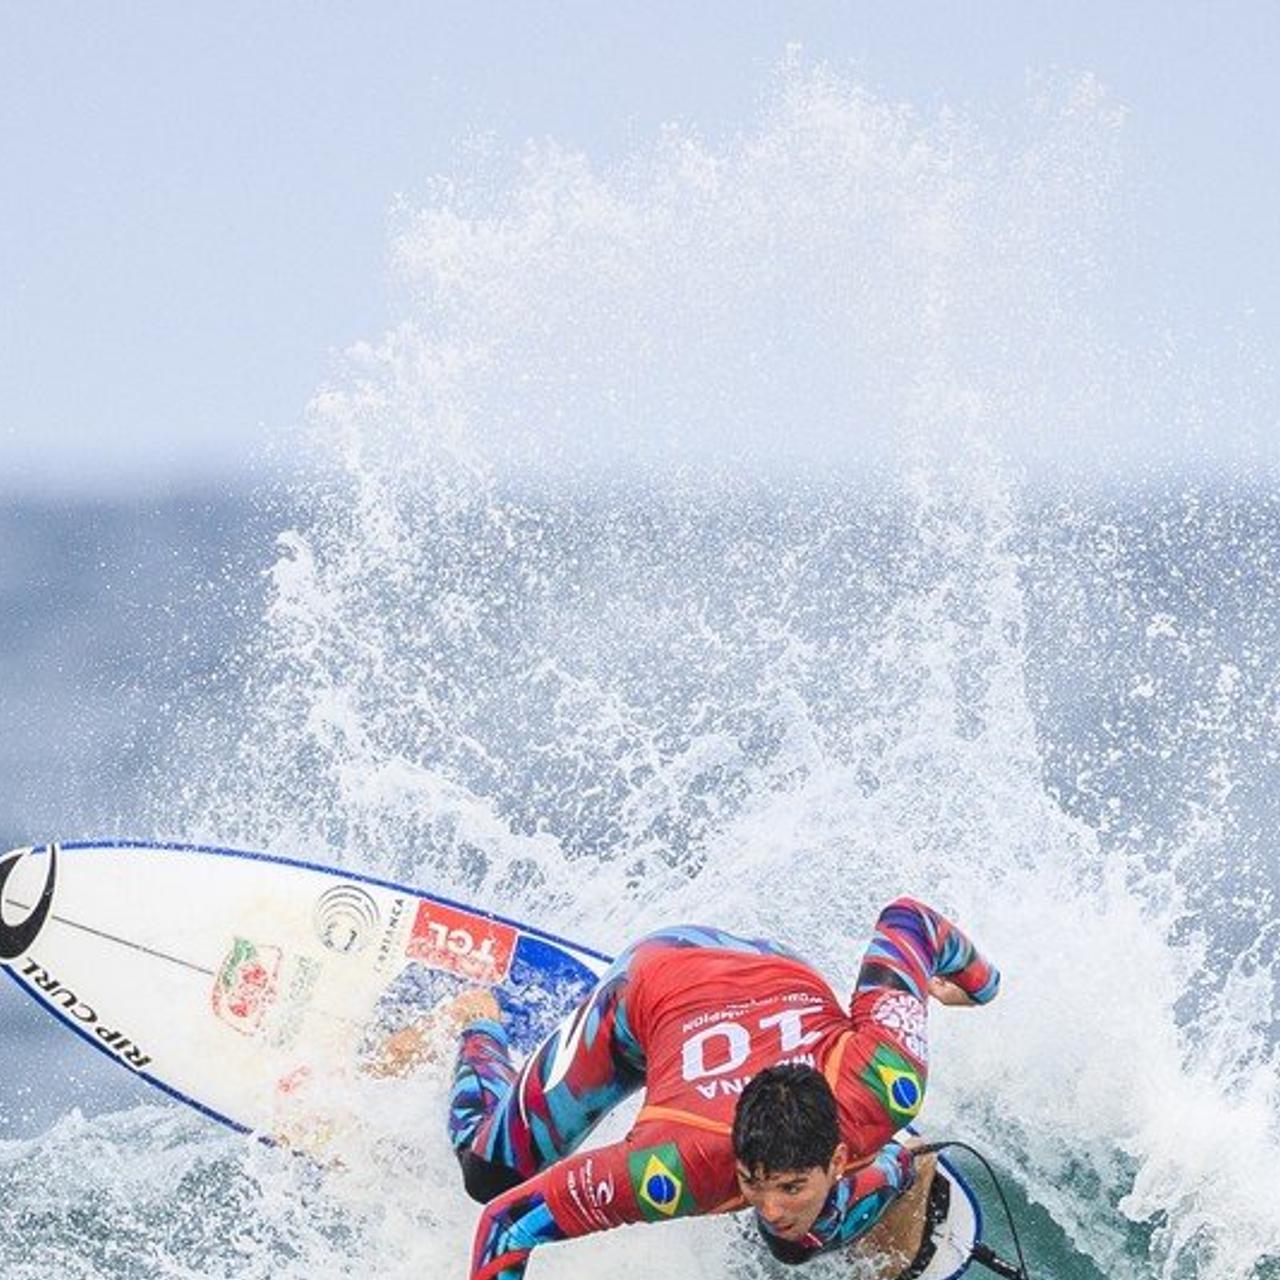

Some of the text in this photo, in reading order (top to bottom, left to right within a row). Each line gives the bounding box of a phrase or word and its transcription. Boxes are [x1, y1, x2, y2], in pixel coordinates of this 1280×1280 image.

[429, 921, 495, 963] TCL
[22, 956, 151, 1068] RIP CURL
[682, 1006, 823, 1081] 10
[696, 1053, 817, 1099] MNA
